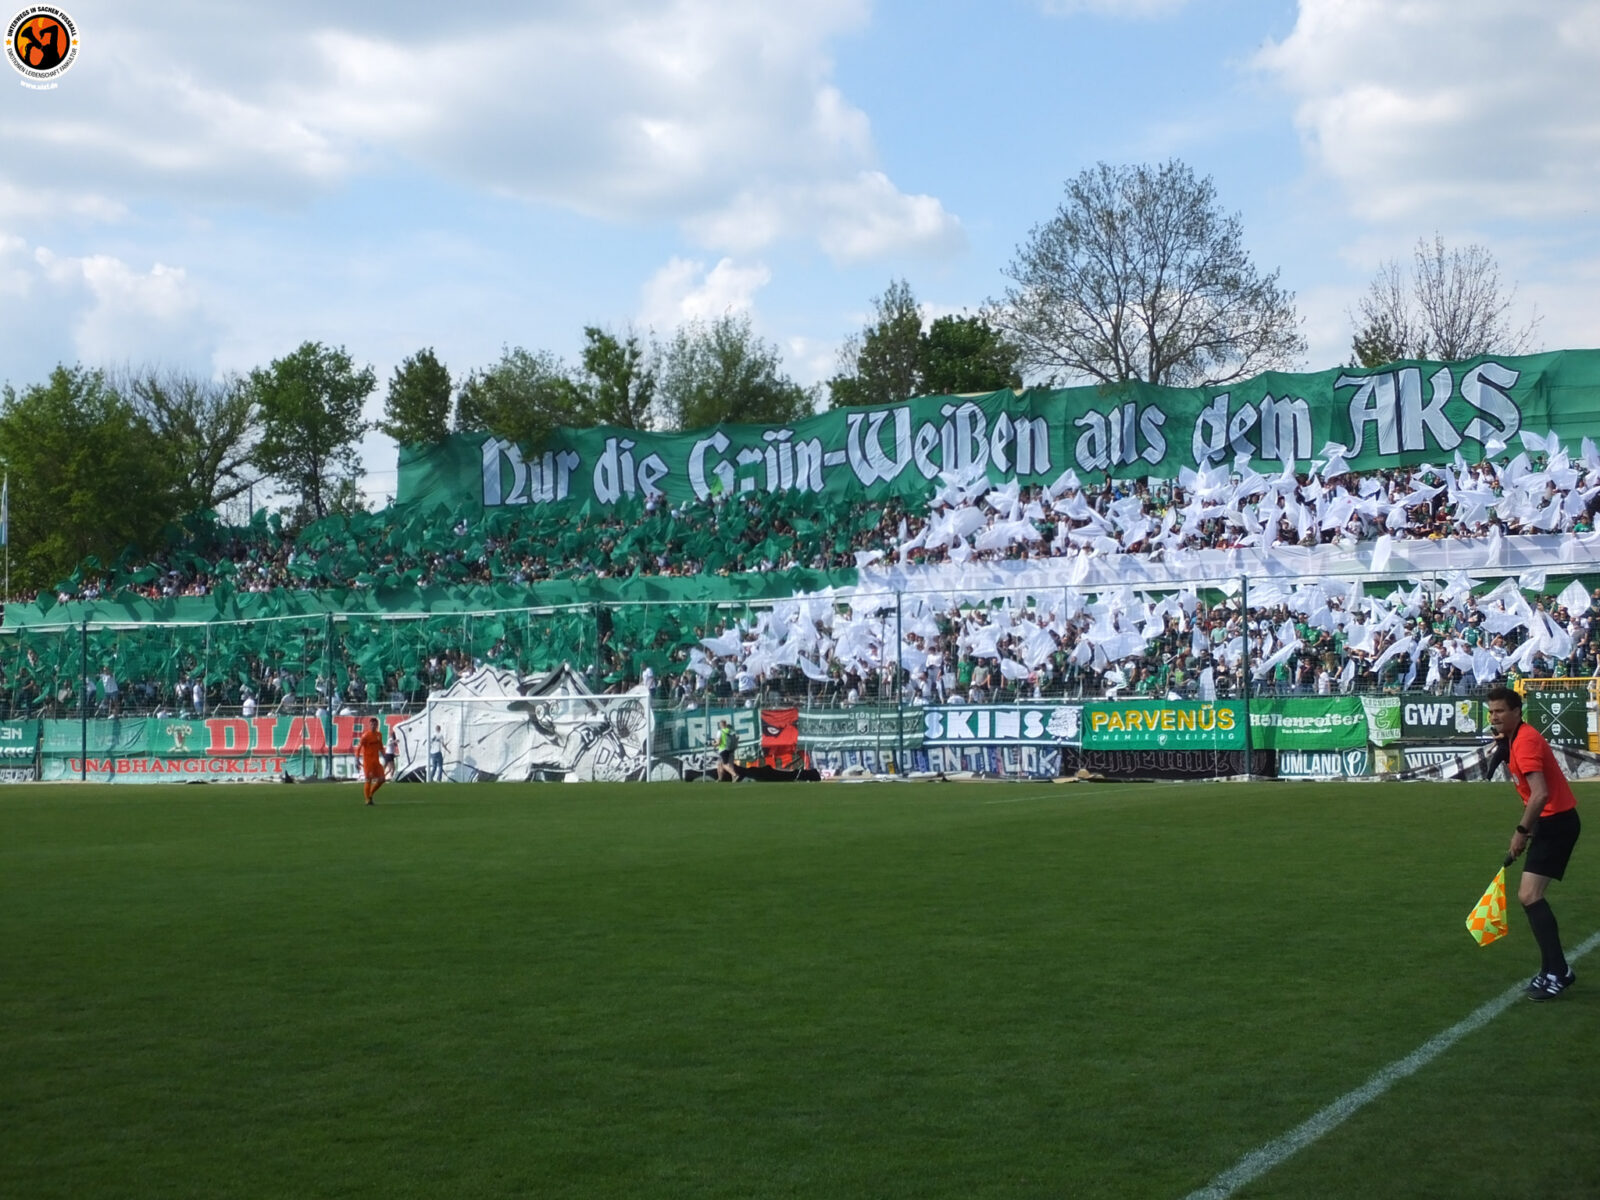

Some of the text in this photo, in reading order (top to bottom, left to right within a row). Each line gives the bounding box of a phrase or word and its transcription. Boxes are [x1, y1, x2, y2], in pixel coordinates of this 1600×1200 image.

[481, 435, 581, 505] Nur
[593, 436, 670, 504] die
[1072, 401, 1168, 473] aus
[1191, 391, 1314, 465] dem
[1333, 360, 1522, 460] AKS
[1535, 691, 1579, 700] STABIL
[924, 710, 1045, 740] SKINS
[1091, 703, 1236, 732] PARVENÜS
[1404, 703, 1455, 726] GWP
[1092, 732, 1236, 742] CHEMIE LEIPZIG
[1003, 746, 1059, 775] LOK
[1281, 753, 1342, 774] UMLAND
